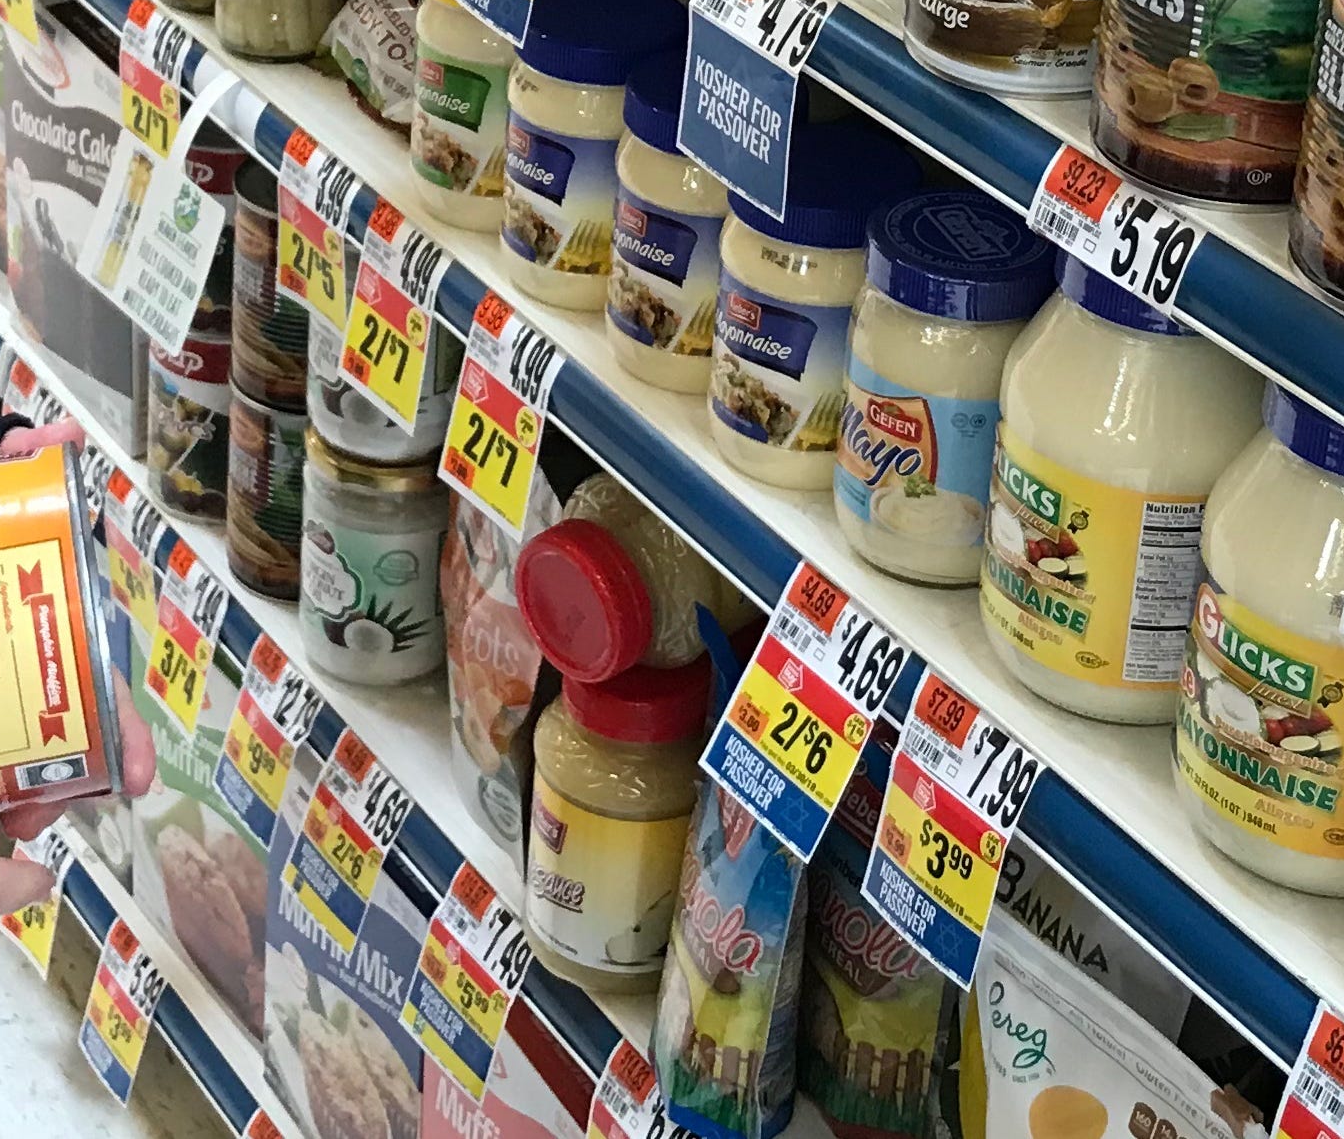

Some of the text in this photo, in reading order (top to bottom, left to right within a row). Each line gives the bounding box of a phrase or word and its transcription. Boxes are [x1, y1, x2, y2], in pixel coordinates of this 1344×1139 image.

[11, 100, 76, 155] Chocolate
[131, 95, 170, 153] 2/$7
[694, 55, 783, 142] KOSHER FOR
[697, 91, 772, 165] PASSOVER
[1061, 158, 1106, 205] $9.23
[292, 233, 336, 300] 2/$5
[1110, 193, 1198, 306] $5.19
[359, 313, 410, 384] 2/$7
[510, 325, 557, 406] $4.99
[462, 413, 520, 488] 2/$7
[843, 400, 923, 487] Mayo
[868, 403, 919, 439] GEFEN
[800, 577, 834, 620] $4.69
[160, 638, 197, 706] 3/$4
[837, 612, 905, 713] $4.69
[1197, 591, 1313, 694] GLICKS
[770, 702, 835, 776] 2/$6
[927, 687, 966, 732] $7.99
[721, 753, 770, 811] PASSOVER
[725, 733, 786, 799] KOSHER FOR
[967, 725, 1039, 830] $7.99
[356, 939, 405, 1003] Mix
